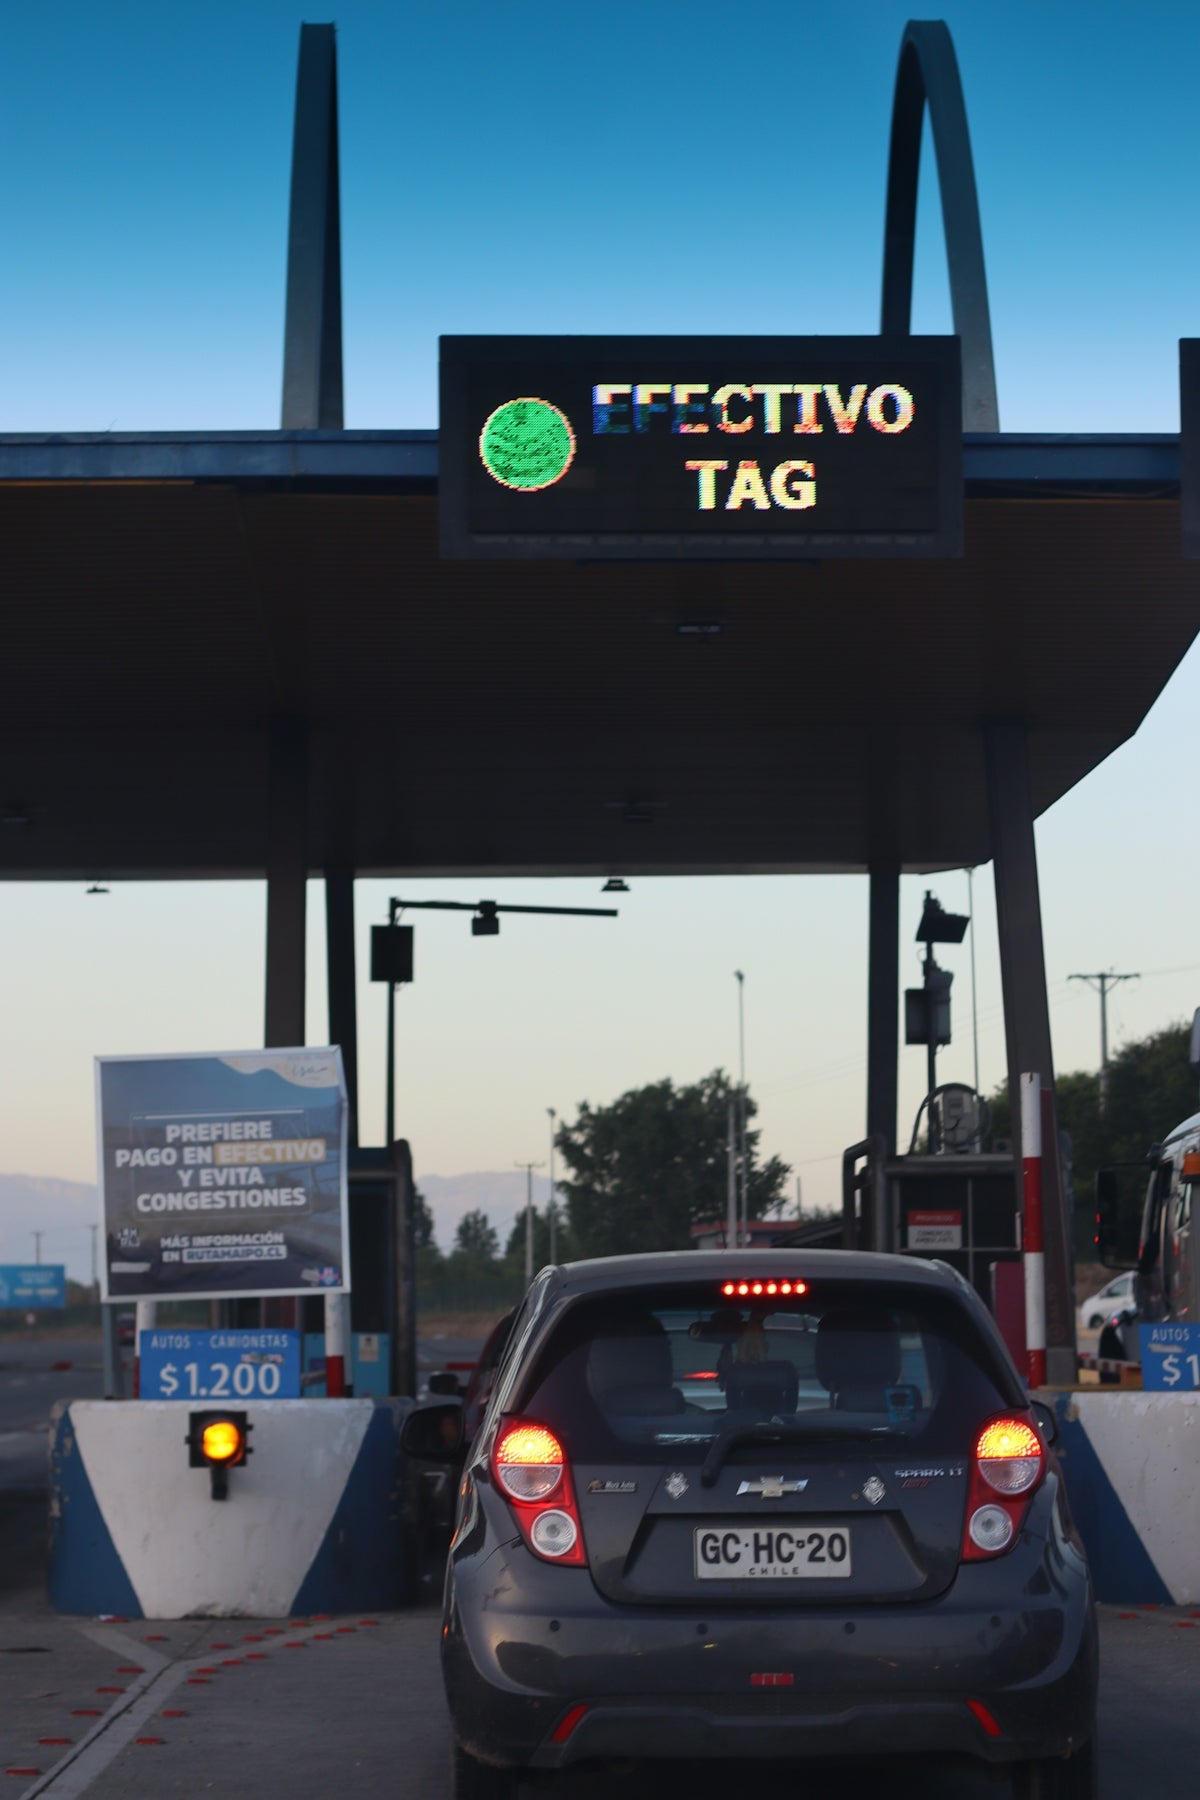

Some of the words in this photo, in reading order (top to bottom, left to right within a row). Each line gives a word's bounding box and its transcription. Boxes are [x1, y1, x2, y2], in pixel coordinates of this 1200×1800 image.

[593, 383, 915, 435] EFECTIVO
[685, 459, 817, 511] TAG
[166, 1121, 272, 1143] PREFIERE
[115, 1148, 177, 1168] PAGO
[183, 1146, 213, 1165] EN
[218, 1141, 325, 1164] EFECTIVO
[177, 1169, 194, 1187] Y
[199, 1166, 264, 1187] EVITA
[136, 1187, 307, 1212] CONGESTIONES
[160, 1233, 190, 1249] MÁS
[192, 1231, 285, 1247] INFORMACIÓN
[162, 1250, 180, 1262] EN
[151, 1335, 190, 1348] AUTOS
[209, 1334, 288, 1348] CAMIONETAS
[1152, 1328, 1190, 1342] AUTOS
[160, 1362, 280, 1397] $1.200
[749, 1567, 799, 1575] CHILE
